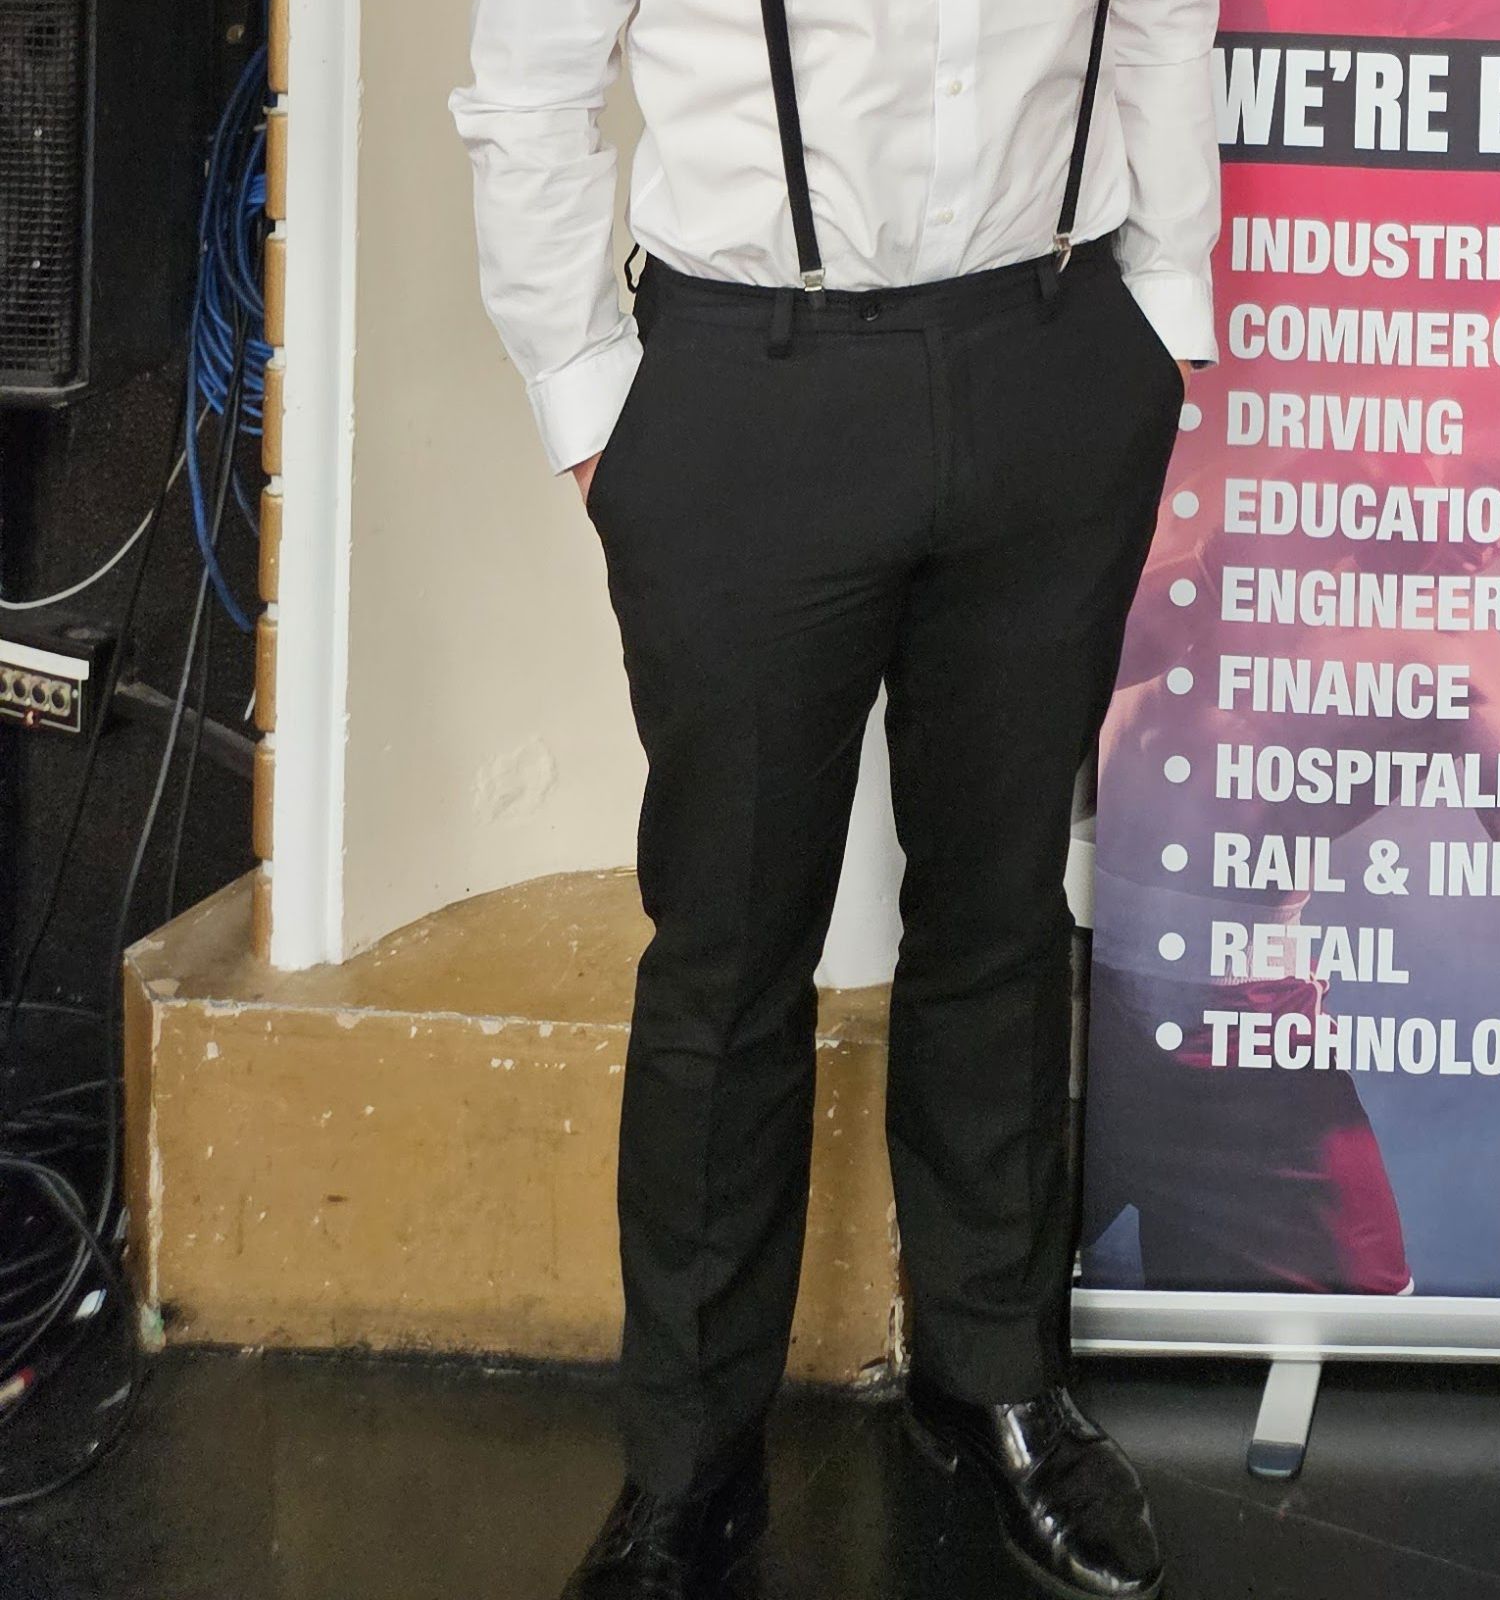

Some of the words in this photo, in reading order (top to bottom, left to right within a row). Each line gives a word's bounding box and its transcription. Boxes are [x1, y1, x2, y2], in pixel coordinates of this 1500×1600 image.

[1210, 46, 1450, 153] WE’RE
[1225, 389, 1464, 457] DRIVING
[1217, 654, 1471, 720] FINANCE
[1212, 831, 1346, 893] RAIL
[1363, 840, 1409, 897] &
[1208, 920, 1410, 984] RETAIL
